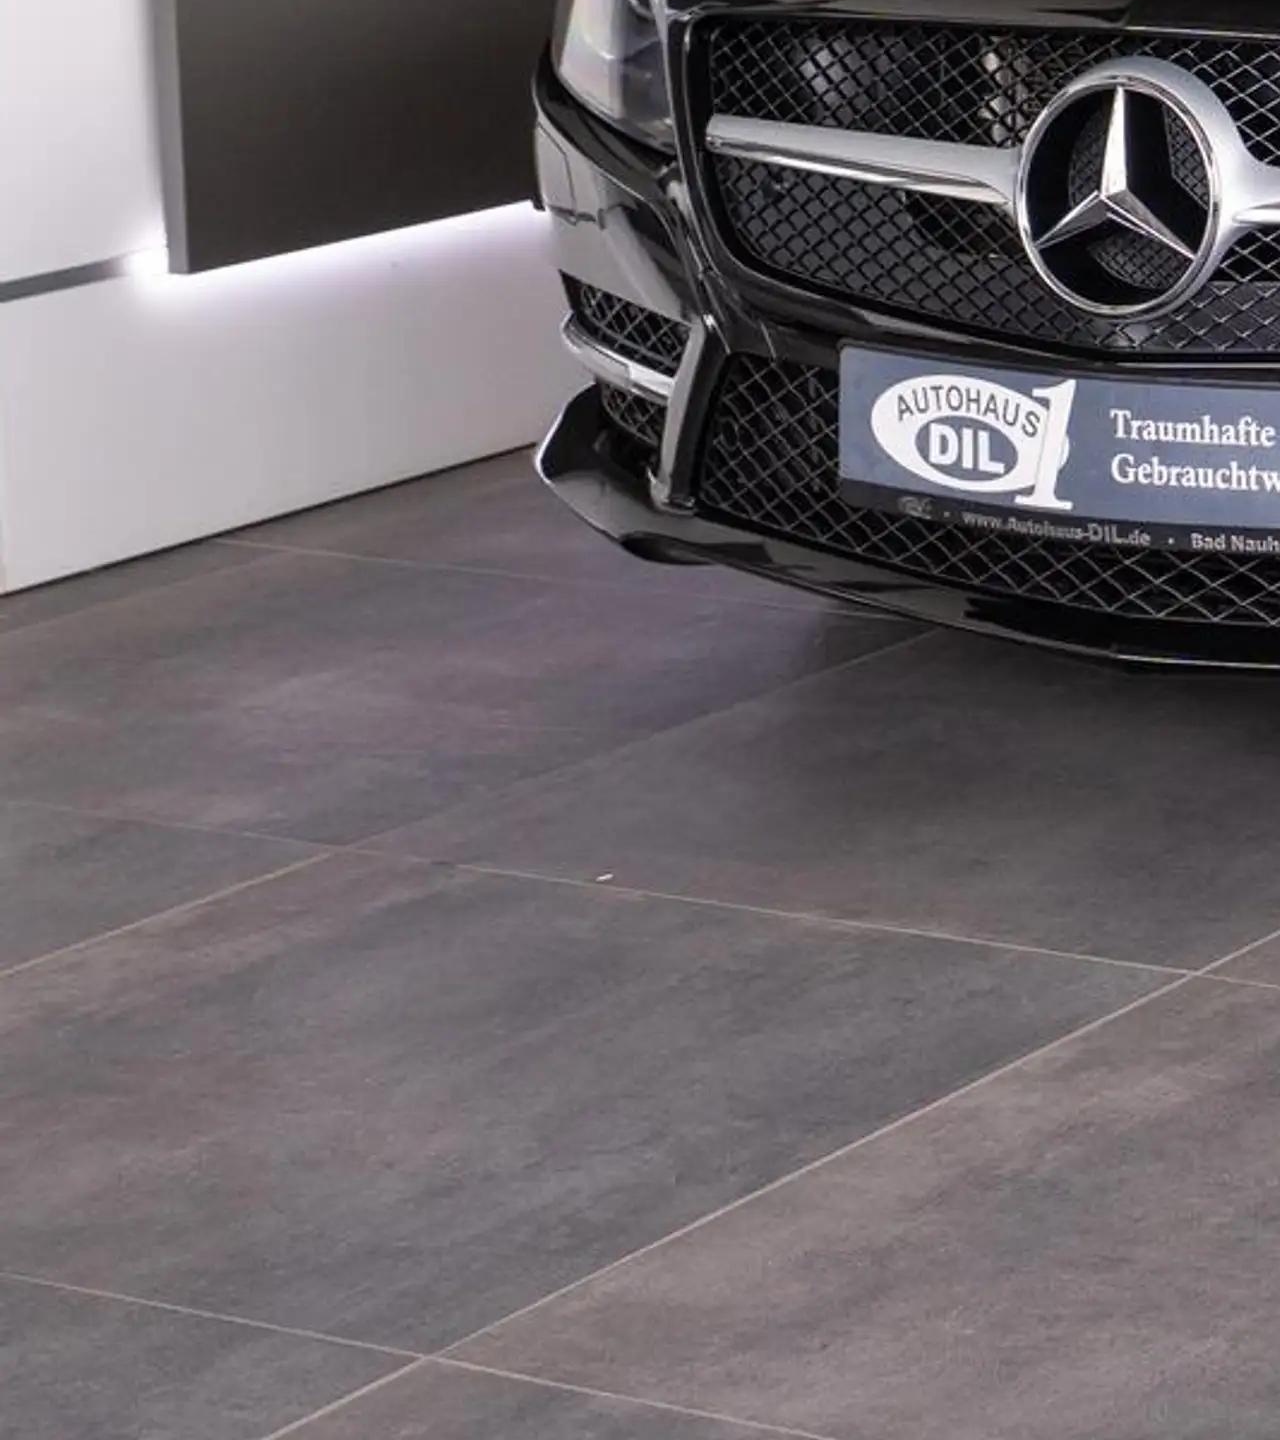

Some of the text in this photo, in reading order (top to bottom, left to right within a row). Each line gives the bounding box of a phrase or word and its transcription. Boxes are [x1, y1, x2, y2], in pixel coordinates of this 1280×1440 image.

[897, 385, 1041, 438] AUTOHAUS
[1109, 409, 1276, 448] Traumhafte
[928, 422, 1006, 474] DIL
[962, 511, 1151, 545] www.Autohaus-DIL.de
[1190, 532, 1226, 550] Bad
